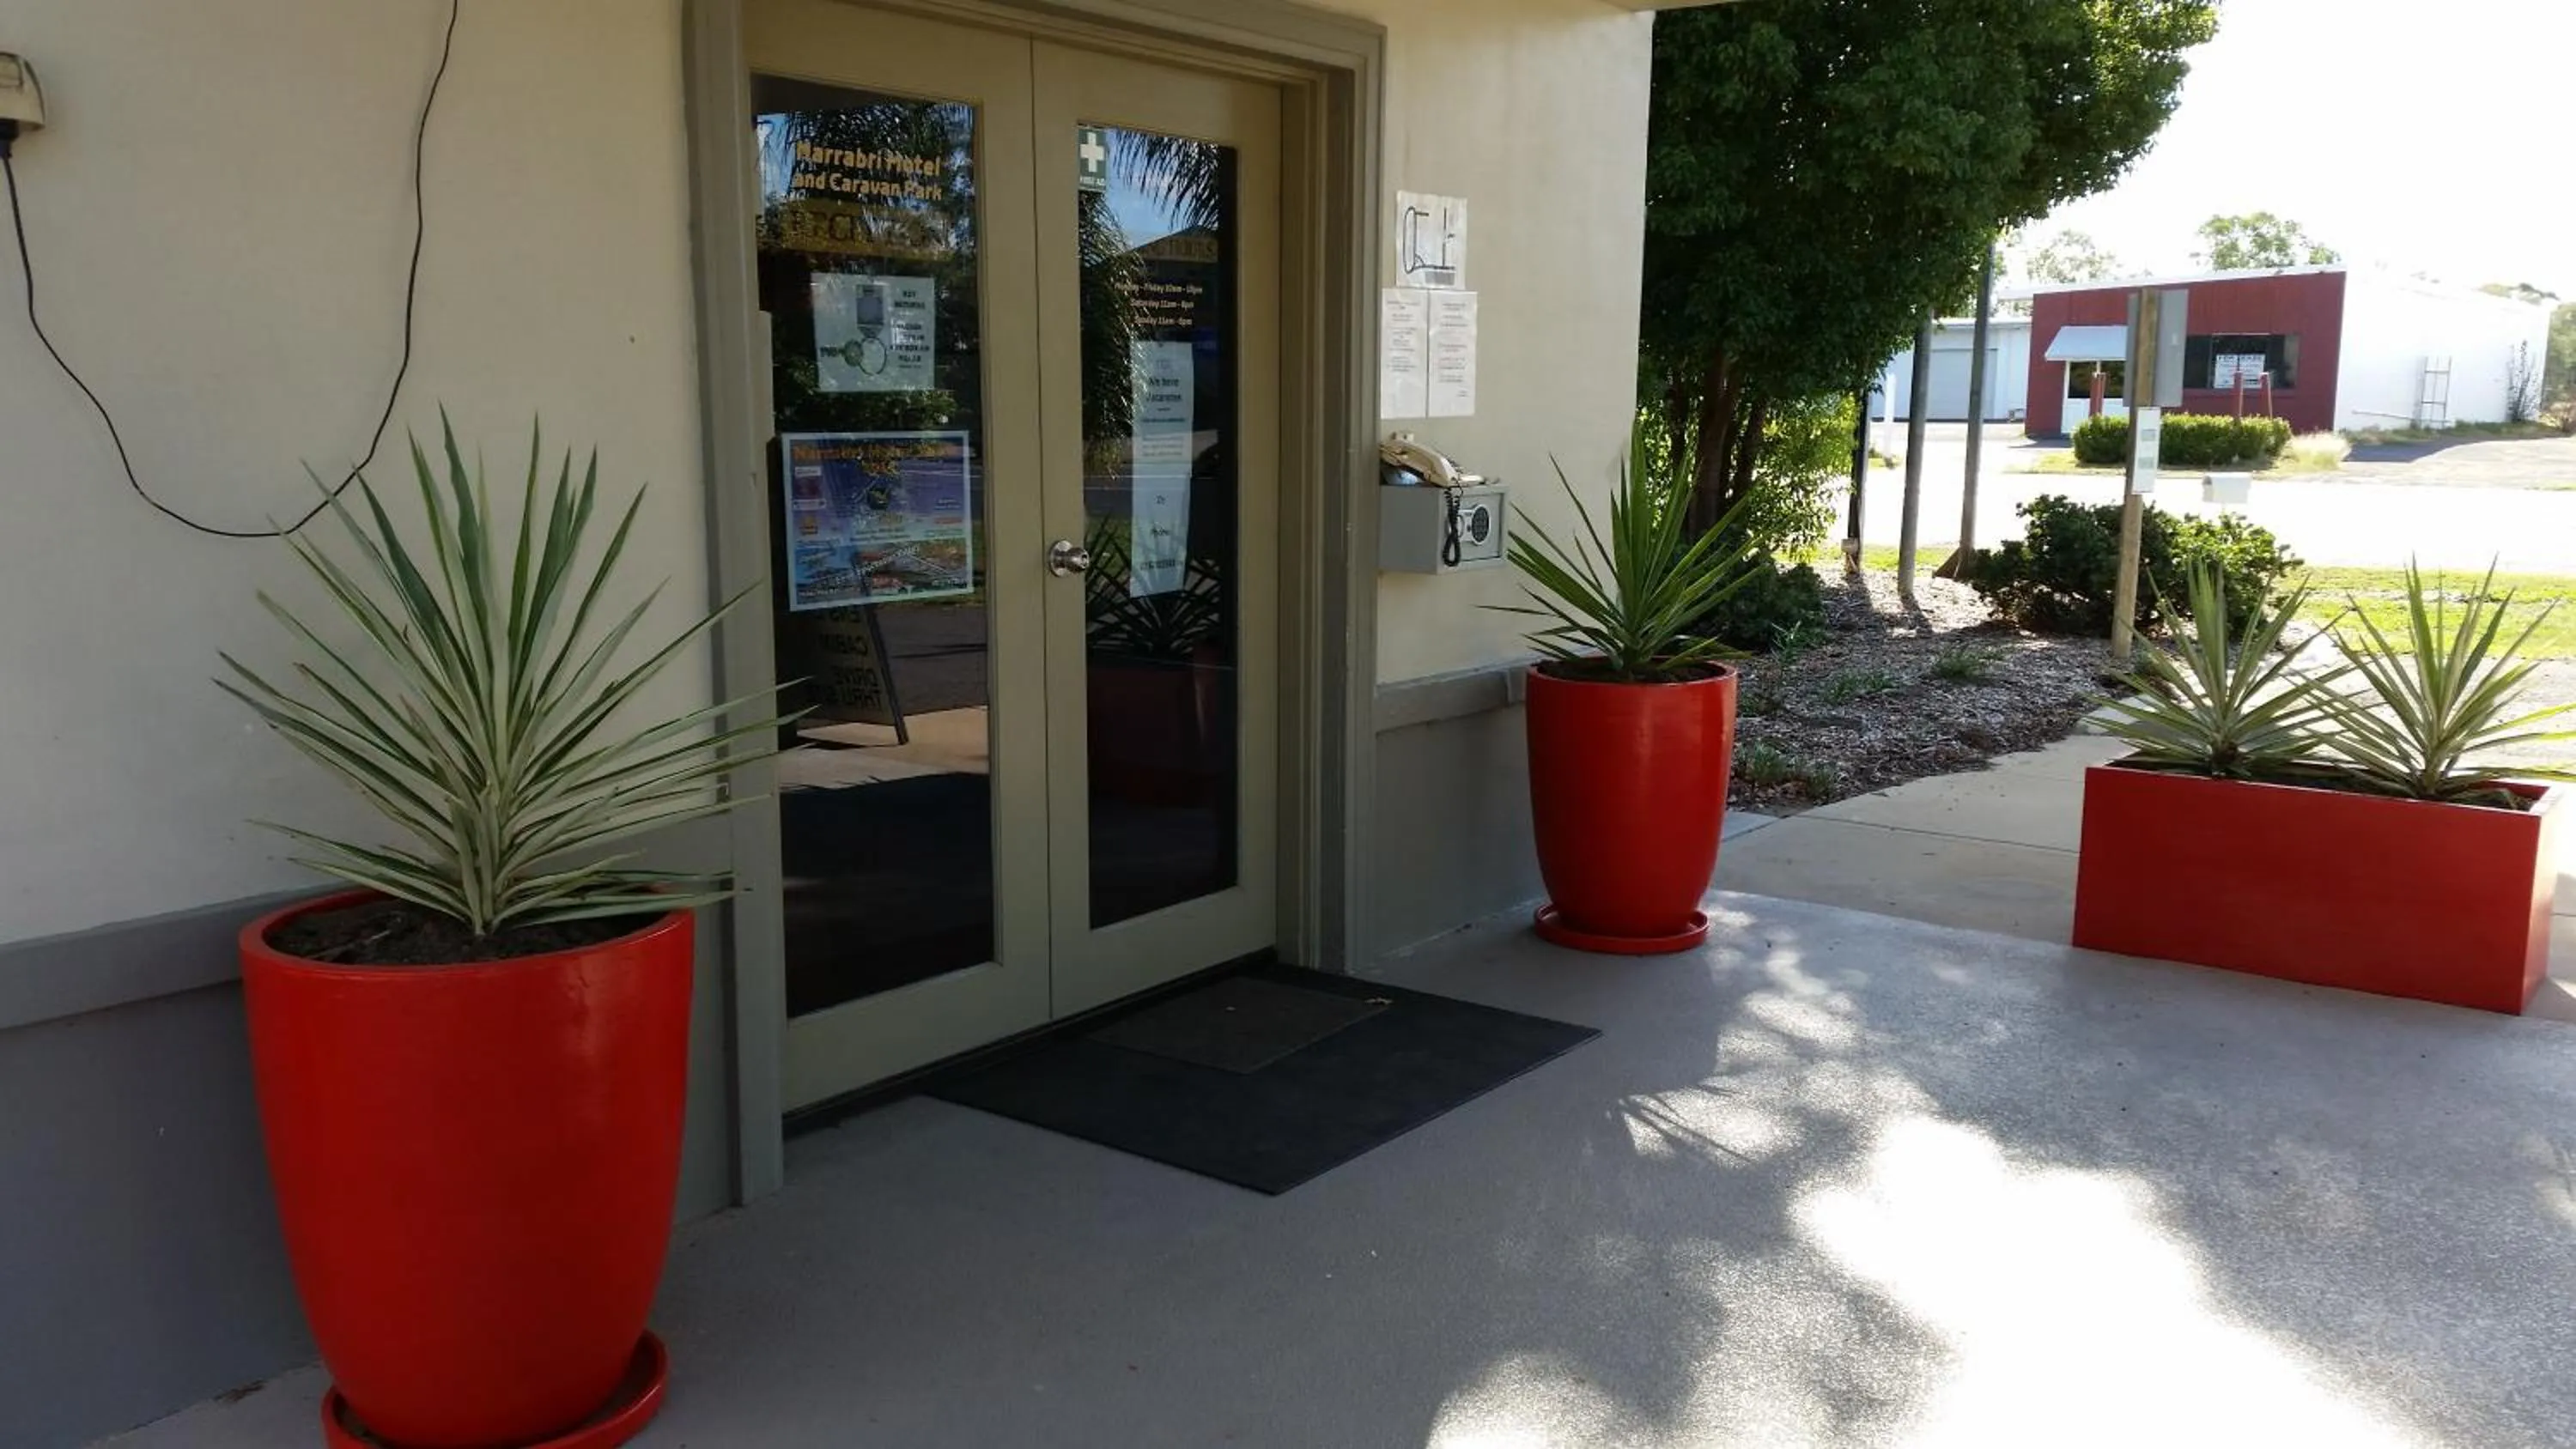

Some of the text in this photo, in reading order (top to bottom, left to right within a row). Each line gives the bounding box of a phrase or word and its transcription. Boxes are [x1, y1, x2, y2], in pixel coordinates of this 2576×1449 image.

[792, 172, 942, 201] and Caravan Park
